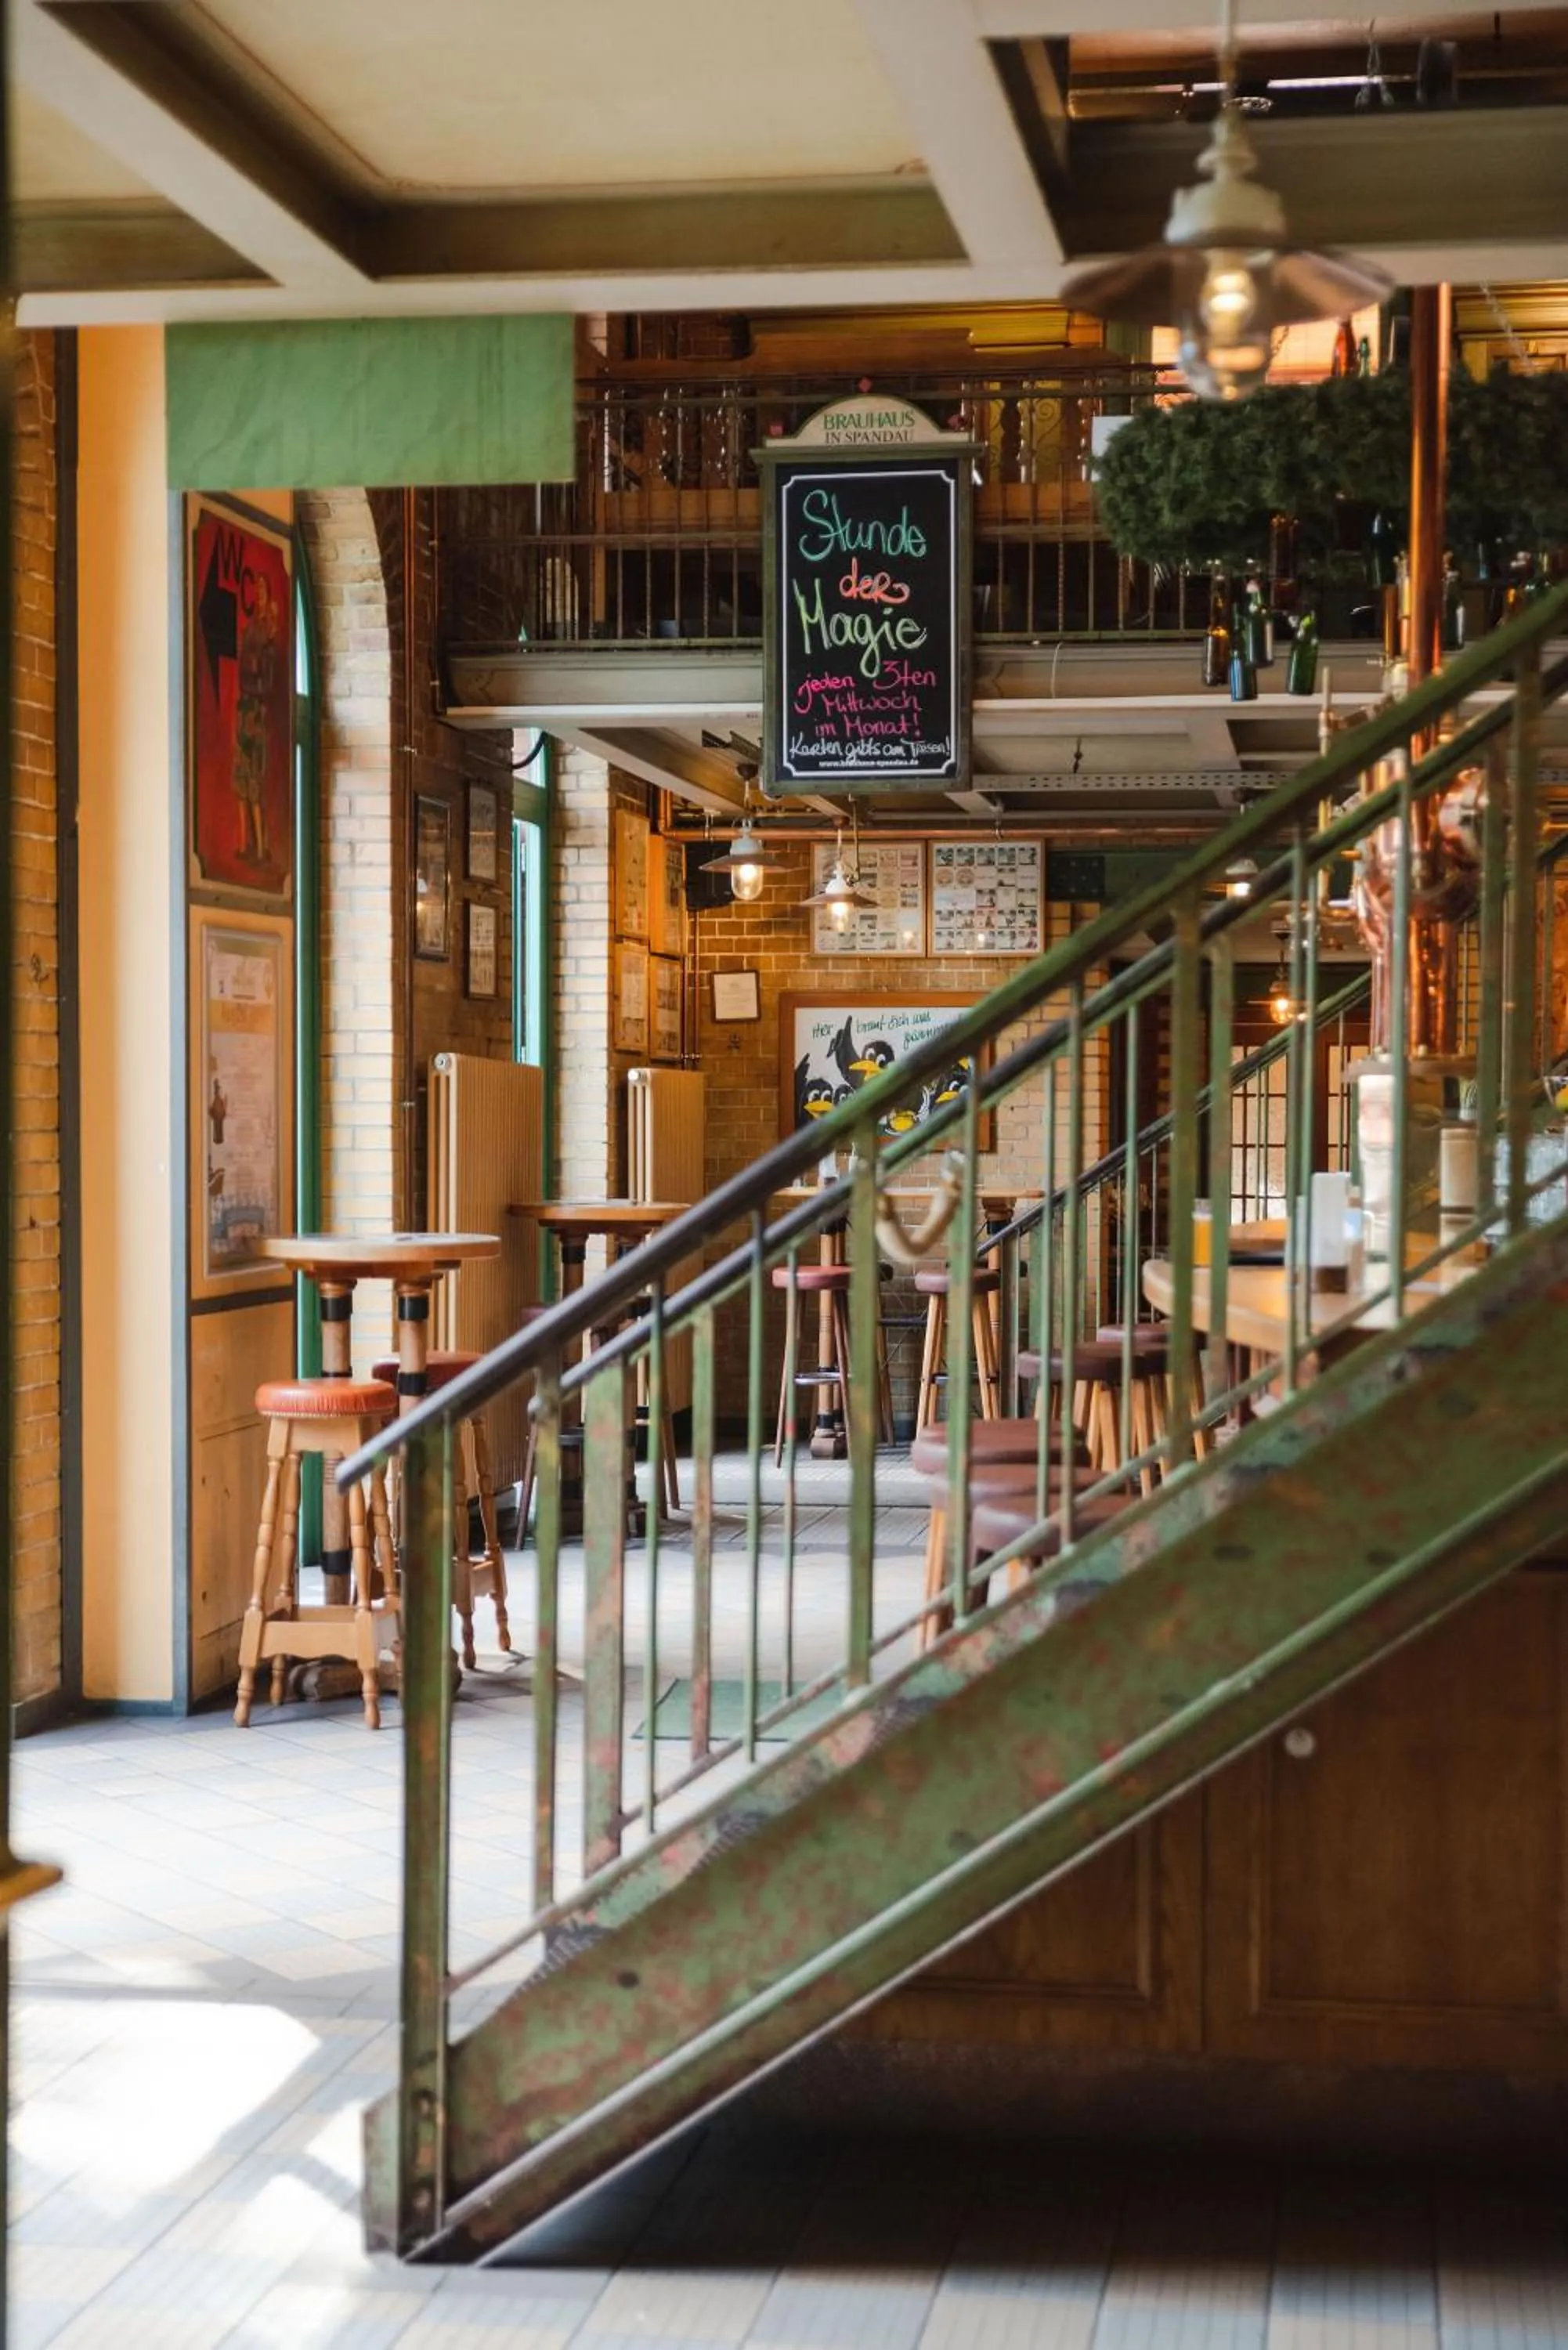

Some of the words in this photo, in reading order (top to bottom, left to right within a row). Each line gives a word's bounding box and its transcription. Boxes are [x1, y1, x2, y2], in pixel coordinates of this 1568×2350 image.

[823, 410, 916, 430] BRAUHAUS
[825, 432, 841, 445] IN
[845, 428, 915, 444] SPANDAU
[799, 489, 927, 561] Stunde
[793, 577, 928, 678] Magie
[793, 671, 856, 714] jeden
[872, 660, 937, 690] 3ten
[822, 690, 922, 716] Mittwoch
[815, 718, 836, 737] im
[844, 712, 920, 738] Monat!
[818, 758, 919, 768] www.brhaus-spandau.de
